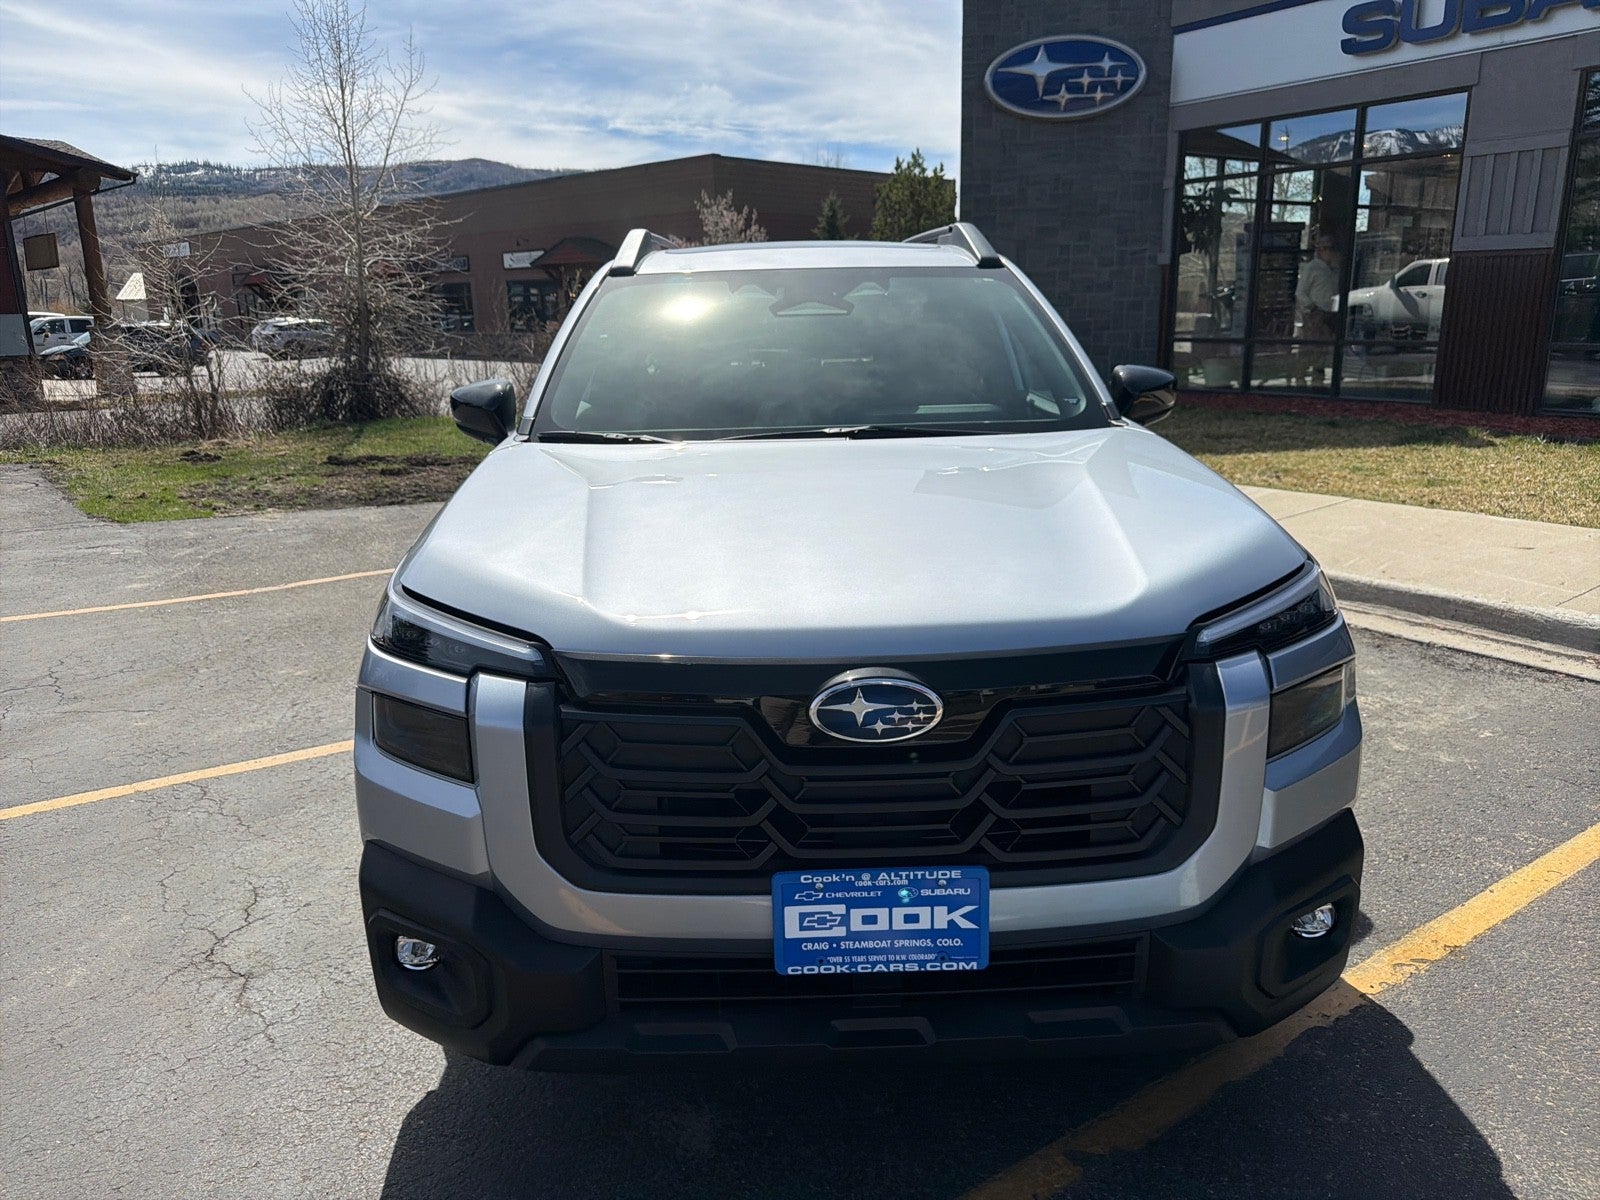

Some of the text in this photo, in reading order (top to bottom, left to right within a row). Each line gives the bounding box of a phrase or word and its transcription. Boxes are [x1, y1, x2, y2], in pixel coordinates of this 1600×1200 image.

[800, 870, 962, 883] Cook'n @ ALTITUDE
[854, 878, 909, 887] cook-cars.com
[825, 888, 970, 898] CHEVROLET SUBARU
[801, 938, 963, 950] CRAIG STEAMBOAT SPRINGS, COLO.
[787, 961, 978, 975] COOK-CARS.COM
